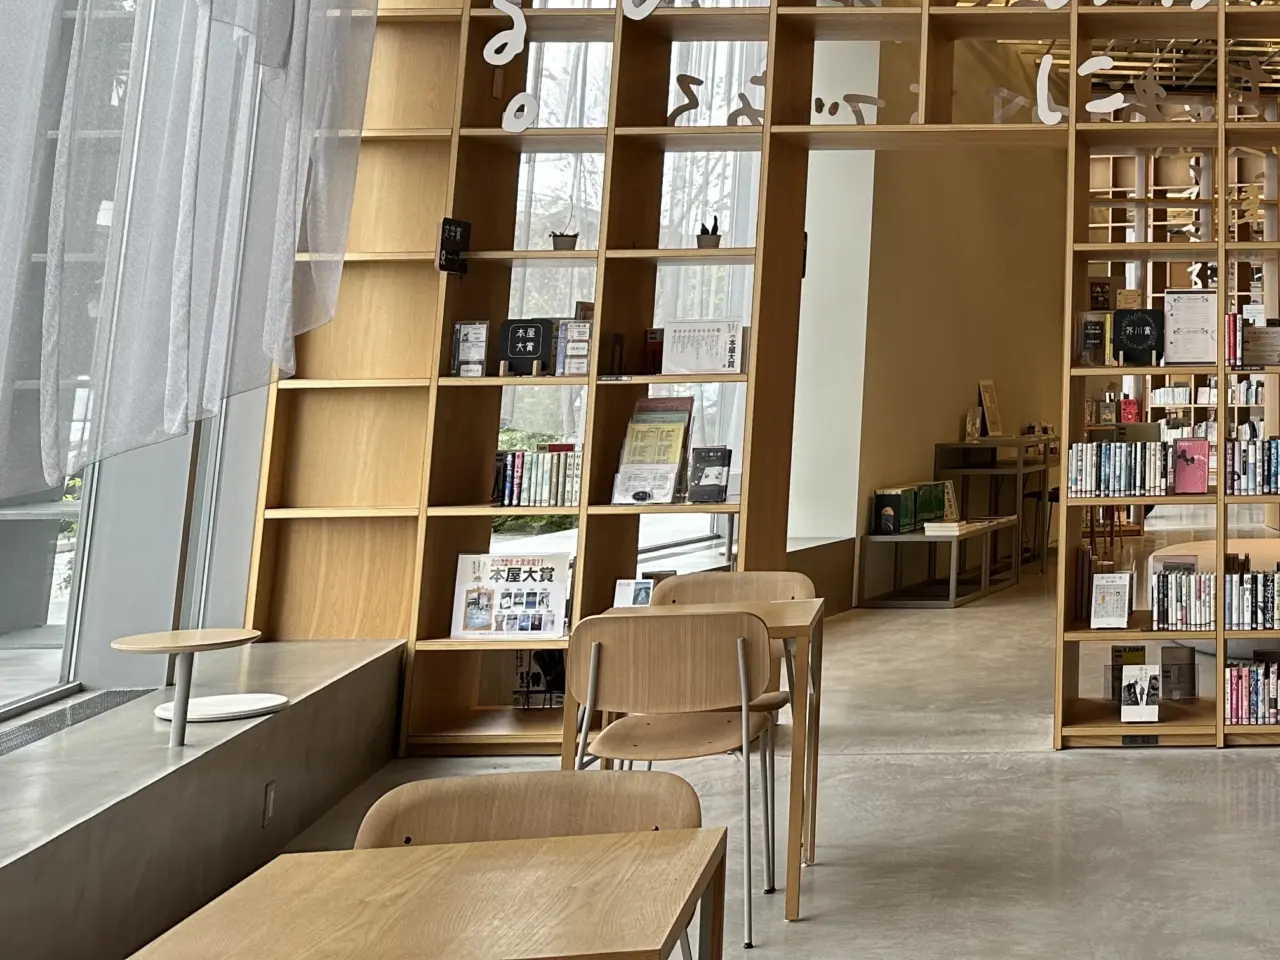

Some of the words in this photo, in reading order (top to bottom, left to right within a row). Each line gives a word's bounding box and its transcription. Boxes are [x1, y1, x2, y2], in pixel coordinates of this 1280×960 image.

[515, 328, 536, 339] 本屋
[1125, 326, 1152, 336] 芥川賞
[515, 341, 536, 352] 大賞
[489, 567, 555, 583] 本屋大賞
